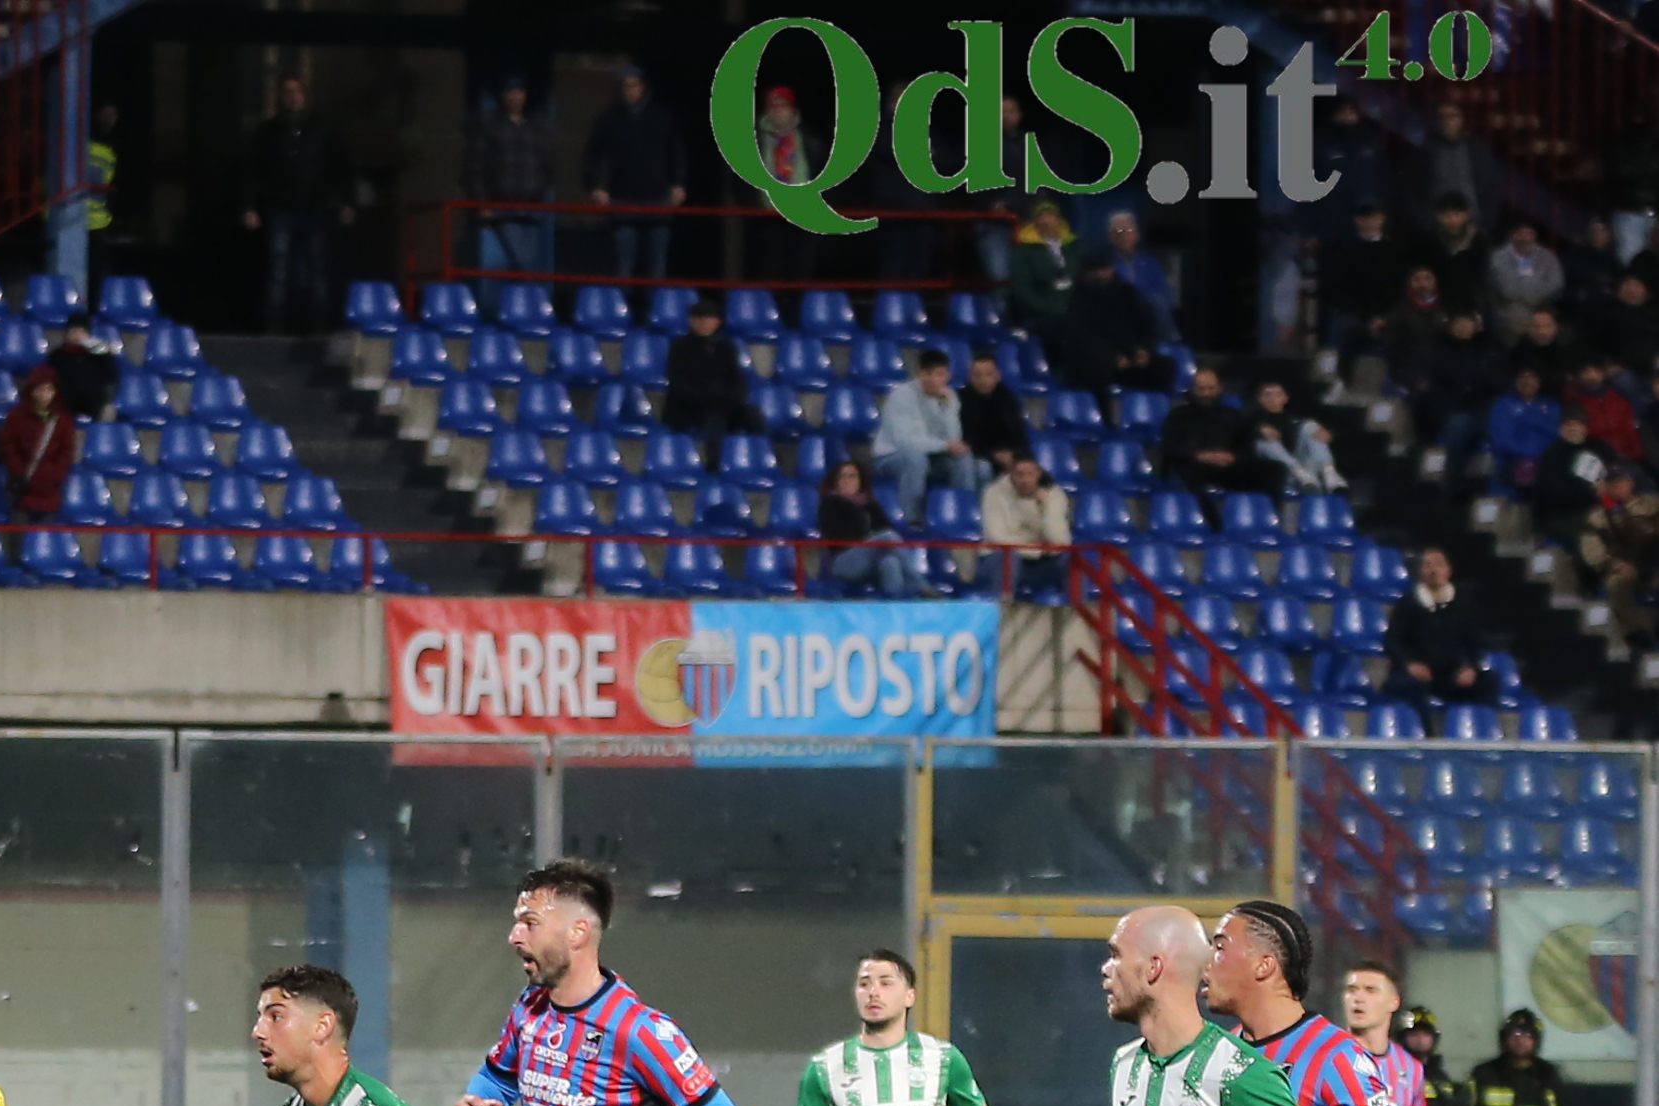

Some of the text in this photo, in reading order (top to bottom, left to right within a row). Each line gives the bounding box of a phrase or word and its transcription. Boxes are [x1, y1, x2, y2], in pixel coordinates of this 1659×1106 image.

[401, 630, 984, 719] GIARRE RIPOSTO
[523, 1069, 571, 1094] SUPER
